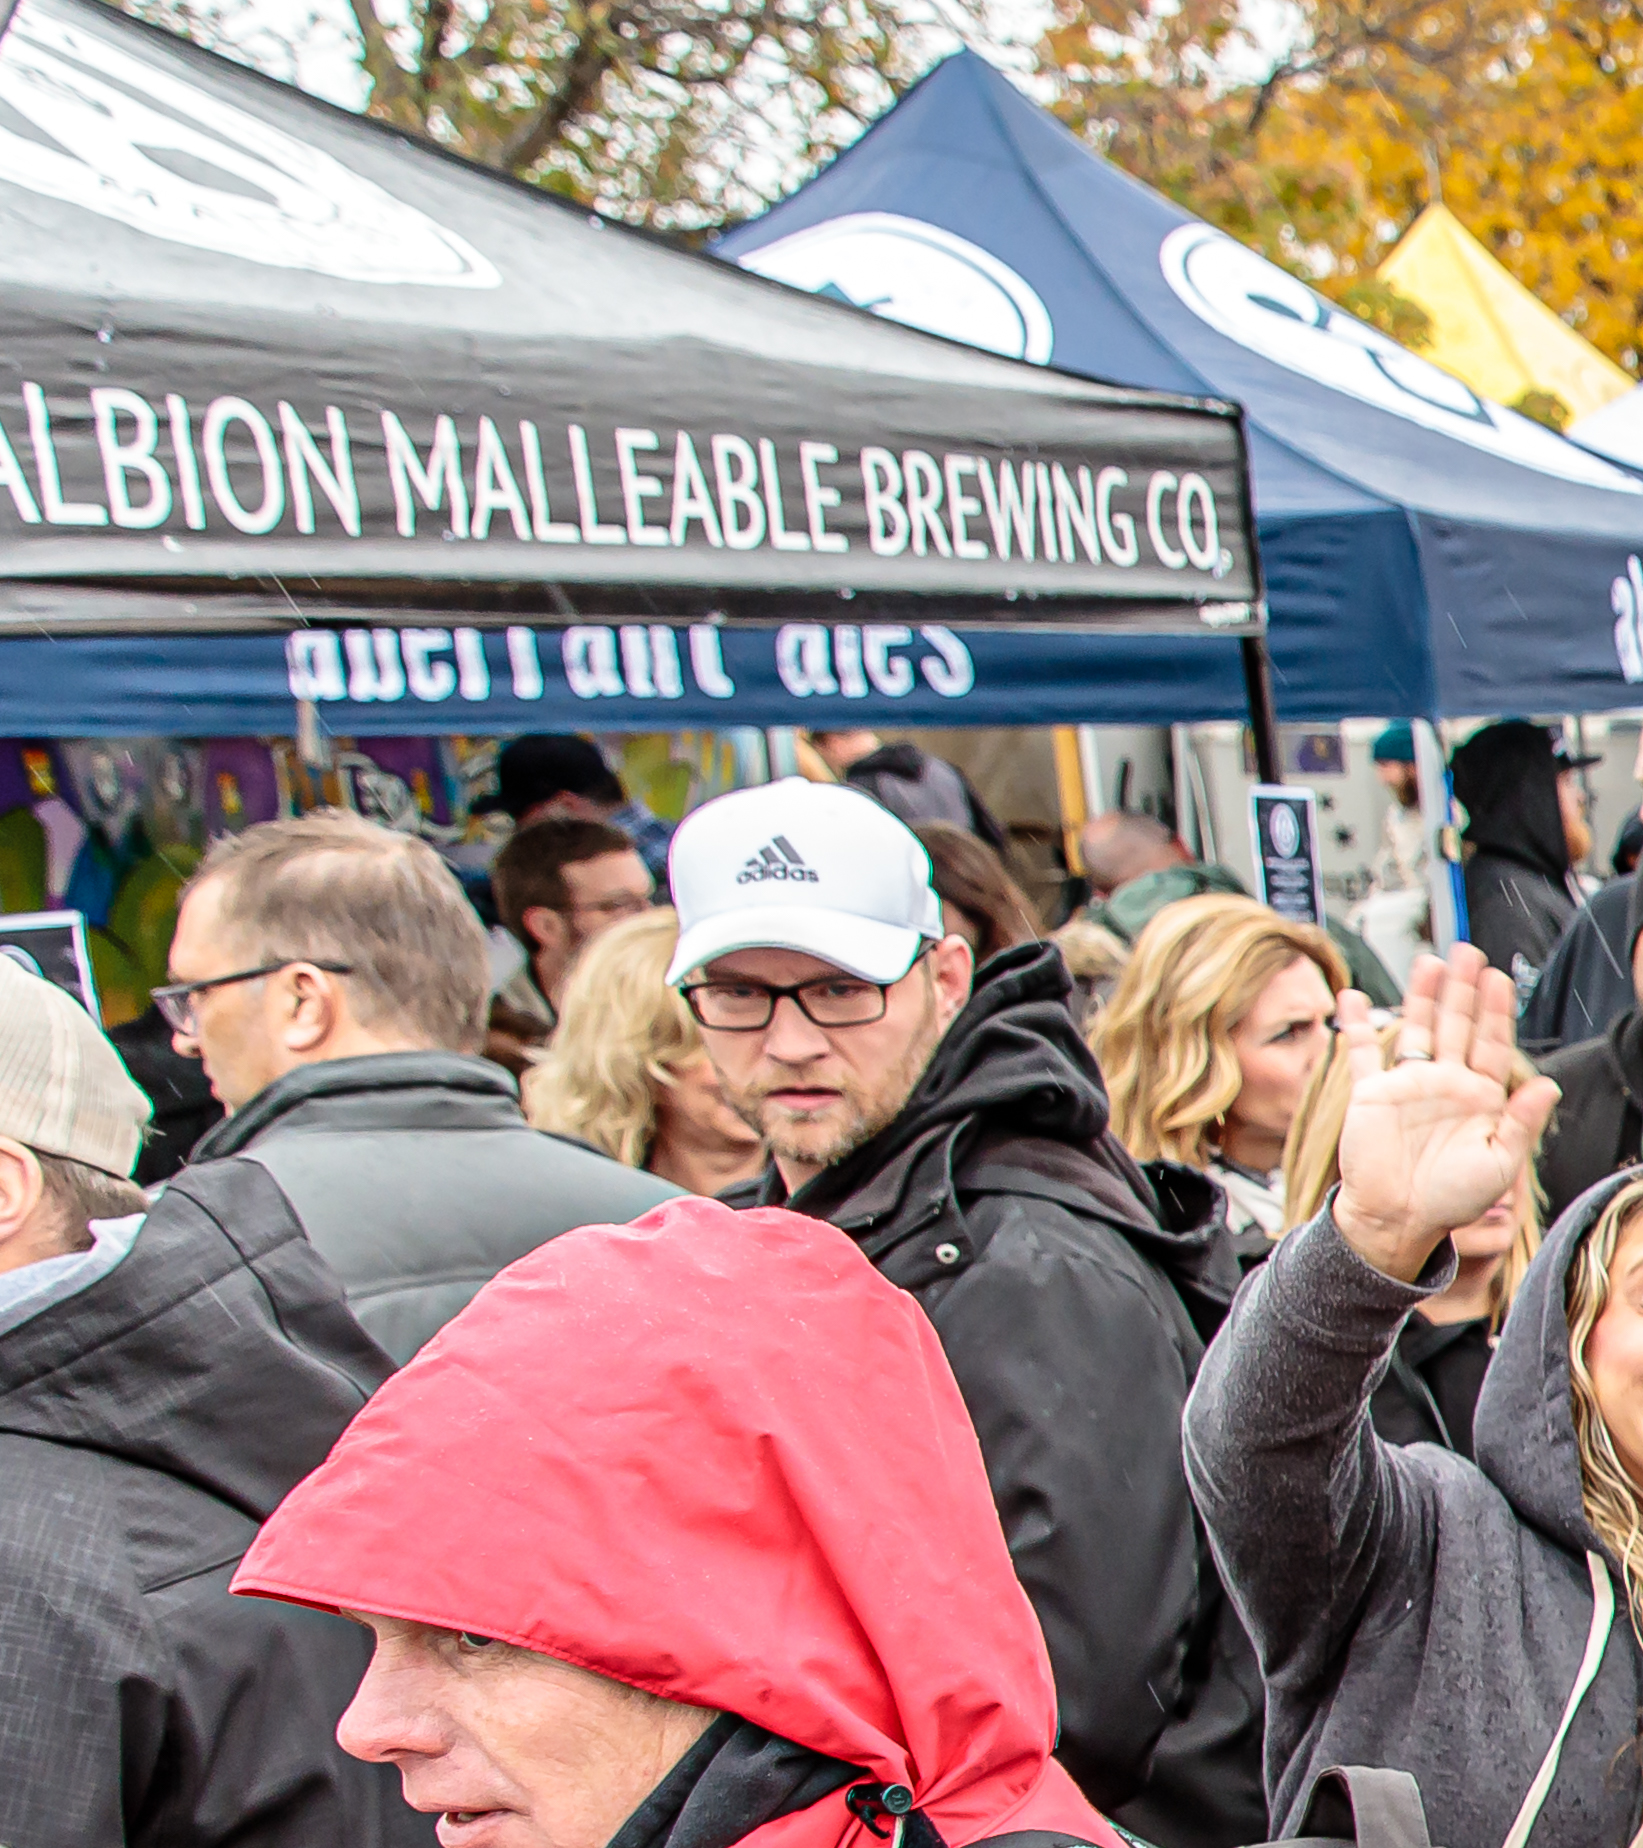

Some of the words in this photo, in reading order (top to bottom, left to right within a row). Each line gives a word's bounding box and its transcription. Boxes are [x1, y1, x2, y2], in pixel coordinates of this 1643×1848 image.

[381, 407, 850, 554] MALLEABLE
[860, 446, 1139, 568] BREWING
[736, 861, 820, 885] adidas
